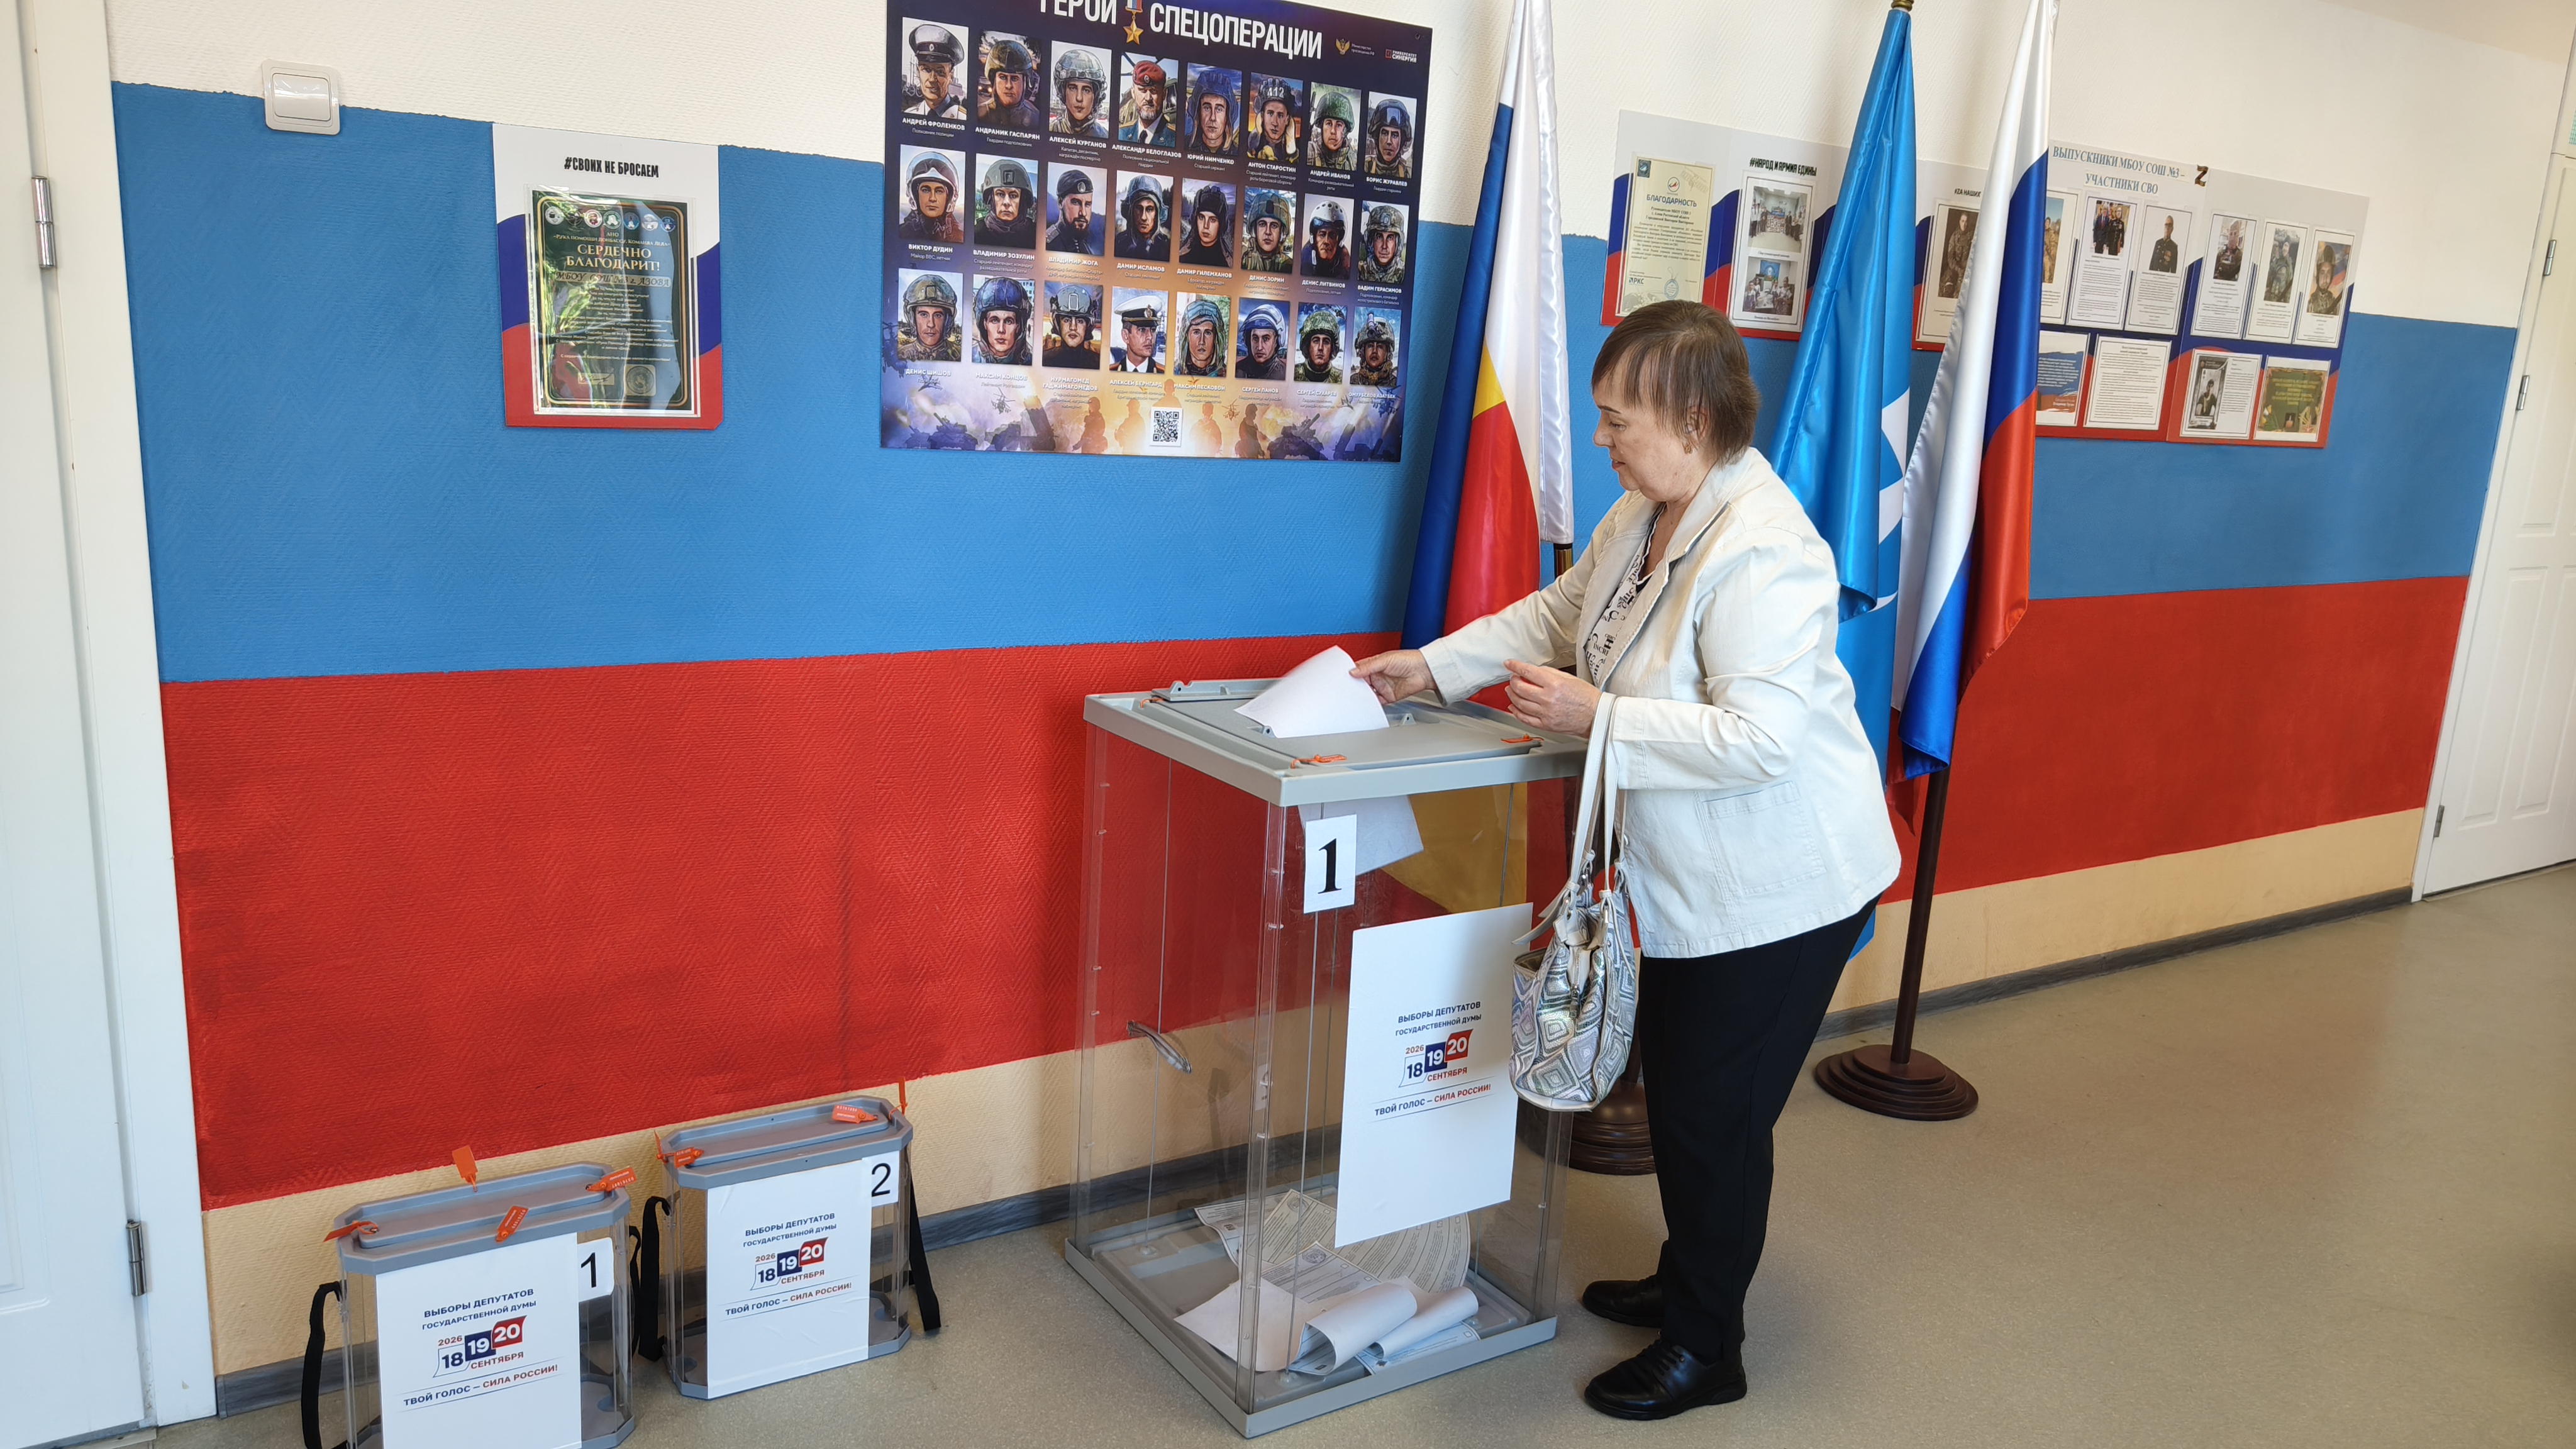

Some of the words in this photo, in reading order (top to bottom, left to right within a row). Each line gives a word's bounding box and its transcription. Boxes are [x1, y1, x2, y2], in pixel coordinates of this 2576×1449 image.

[1150, 3, 1321, 60] СПЕЦОПЕРАЦИИ
[1392, 54, 1417, 63] СИНЕРГИЯ
[902, 118, 926, 126] АНДРЕЙ
[928, 120, 965, 130] ФРОЛЕНКОВ
[975, 127, 1008, 136] АНДРАНИК
[1009, 131, 1040, 140] ГАСПАРЯН
[1050, 136, 1076, 145] АЛЕКСЕЙ
[1077, 140, 1106, 148] КУРГАНОВ
[1112, 144, 1145, 154] АЛЕКСАНДР
[1146, 149, 1182, 157] БЕЛОГЛАЗОВ
[564, 157, 602, 172] #СВОИХ
[605, 160, 615, 174] НЕ
[618, 162, 658, 177] БРОСАЕМ
[1267, 164, 1296, 172] СТАРОСТИН
[1750, 157, 1774, 171] #НАРОД
[1774, 161, 1779, 170] И
[1779, 162, 1797, 173] АРМИЯ
[1798, 165, 1817, 176] ЕДИНЫ
[2053, 146, 2119, 167] ВЫПУСКНИКИ
[2119, 158, 2145, 173] МБОУ
[2146, 162, 2166, 175] СОШ
[2167, 166, 2179, 178] №3
[2085, 173, 2139, 191] УЧАСТНИКИ
[2141, 182, 2158, 194] СВО
[1646, 194, 1697, 207] БЛАГОДАРНОСТЬ
[577, 244, 652, 258] СЕРДЕЧНО
[974, 250, 1006, 258] ВЛАДИМИР
[567, 256, 660, 271] БЛАГОДАРИТ!
[1049, 257, 1081, 265] ВЛАДИМИР
[555, 272, 587, 281] МБОУ
[1318, 838, 1341, 894] 1
[1398, 1010, 1433, 1023] ВЫБОРЫ
[1435, 1001, 1480, 1017] ДЕПУТАТОВ
[1396, 1018, 1460, 1036] ГОСУДАРСТВЕННОЙ
[1462, 1014, 1482, 1024] ДУМЫ
[1406, 1045, 1424, 1054] 2026
[1407, 1062, 1423, 1079] 18
[1428, 1050, 1443, 1067] 19
[1447, 1037, 1467, 1055] 20
[1427, 1067, 1467, 1081] СЕНТЯБРЯ
[1375, 1103, 1396, 1116] ТВОЙ
[1399, 1099, 1425, 1111] ГОЛОС
[1435, 1092, 1455, 1102] СИЛА
[1457, 1084, 1491, 1097] РОССИИ!
[871, 1163, 891, 1197] 2
[745, 1223, 783, 1236] ВЫБОРЫ
[786, 1213, 835, 1229] ДЕПУТАТОВ
[743, 1228, 814, 1247] ГОСУДАРСТВЕННОЙ
[815, 1224, 836, 1234] ДУМЫ
[755, 1253, 775, 1262] 2026
[758, 1269, 775, 1282] 18
[779, 1257, 797, 1271] 19
[801, 1244, 822, 1261] 20
[581, 1252, 596, 1287] 1
[781, 1270, 824, 1284] СЕНТЯБРЯ
[425, 1302, 470, 1318] ВЫБОРЫ
[474, 1289, 534, 1309] ДЕПУТАТОВ
[726, 1304, 749, 1315] ТВОЙ
[752, 1299, 780, 1310] ГОЛОС
[790, 1292, 813, 1301] СИЛА
[816, 1282, 852, 1296] РОССИИ!
[423, 1306, 508, 1330] ГОСУДАРСТВЕННОЙ
[511, 1301, 536, 1313] ДУМЫ
[438, 1336, 462, 1346] 2026
[442, 1352, 464, 1368] 18
[468, 1338, 489, 1355] 19
[494, 1323, 520, 1343] 20
[471, 1352, 523, 1369] СЕНТЯБРЯ
[404, 1392, 433, 1406] ТВОЙ
[436, 1385, 470, 1399] ГОЛОС
[483, 1377, 510, 1388] СИЛА
[514, 1365, 558, 1380] РОССИИ!
